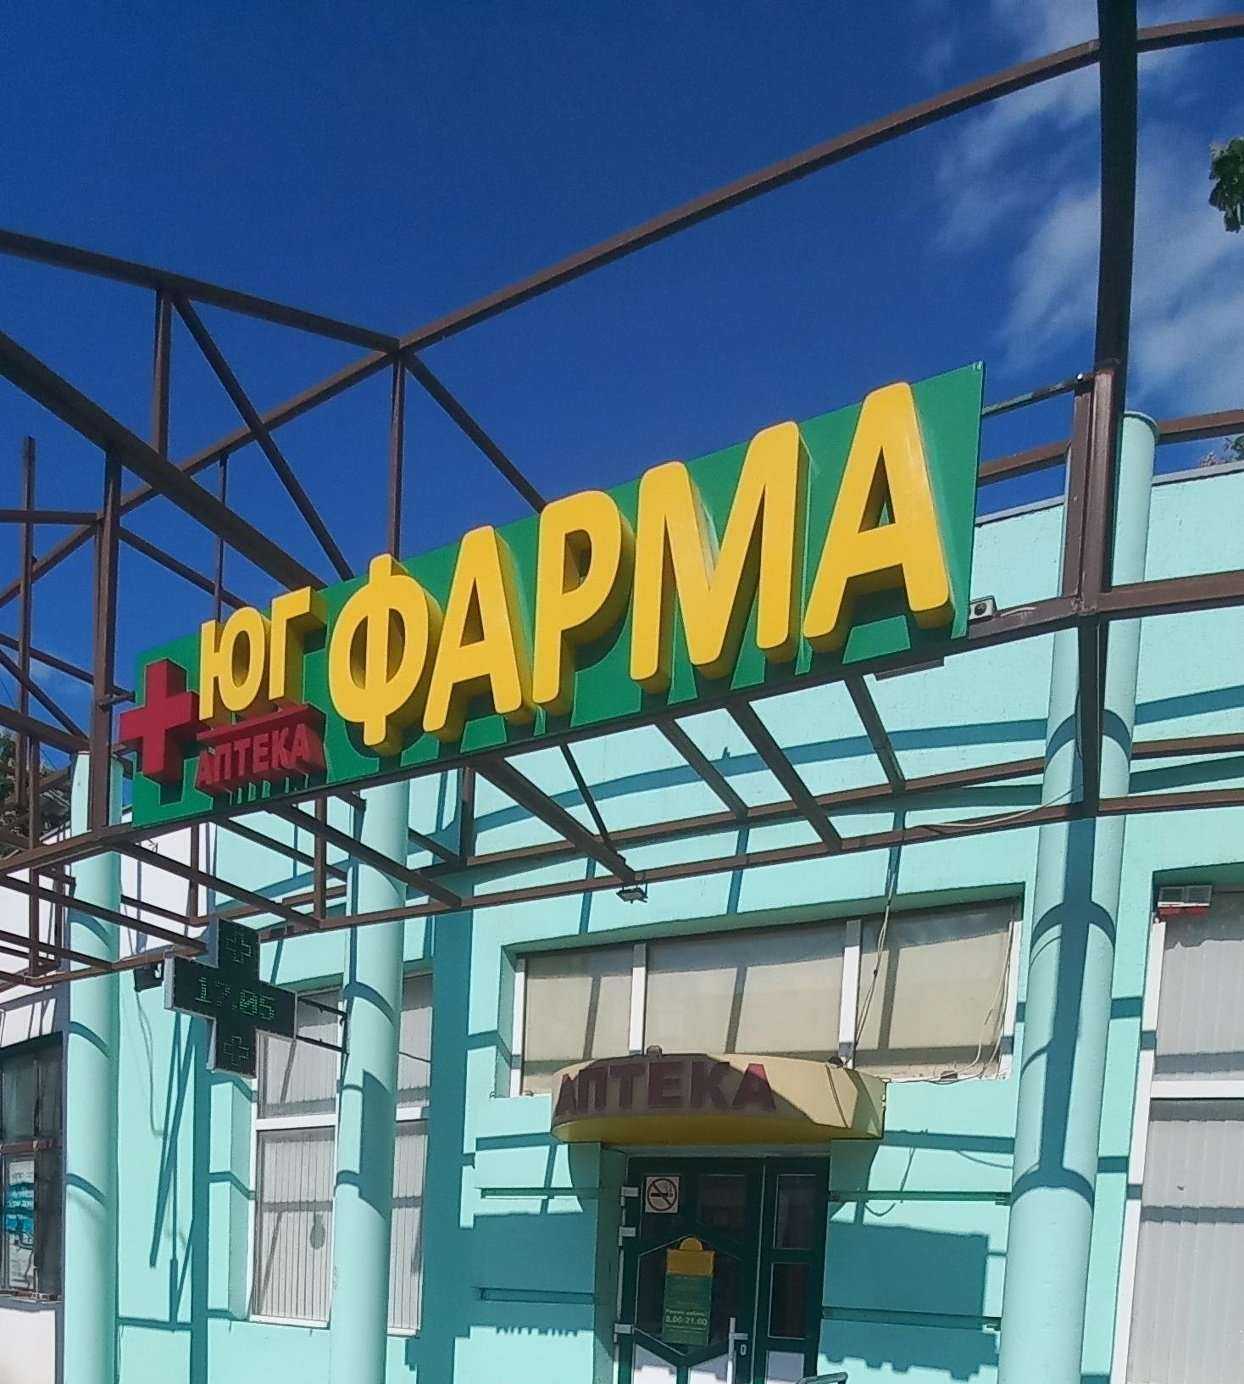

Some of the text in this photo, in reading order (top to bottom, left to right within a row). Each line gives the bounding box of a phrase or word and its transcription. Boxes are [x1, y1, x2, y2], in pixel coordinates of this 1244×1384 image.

[199, 381, 954, 752] ЮГ ФАРМА
[197, 723, 313, 785] АПТЕКА
[555, 1061, 777, 1117] АПТЕКА
